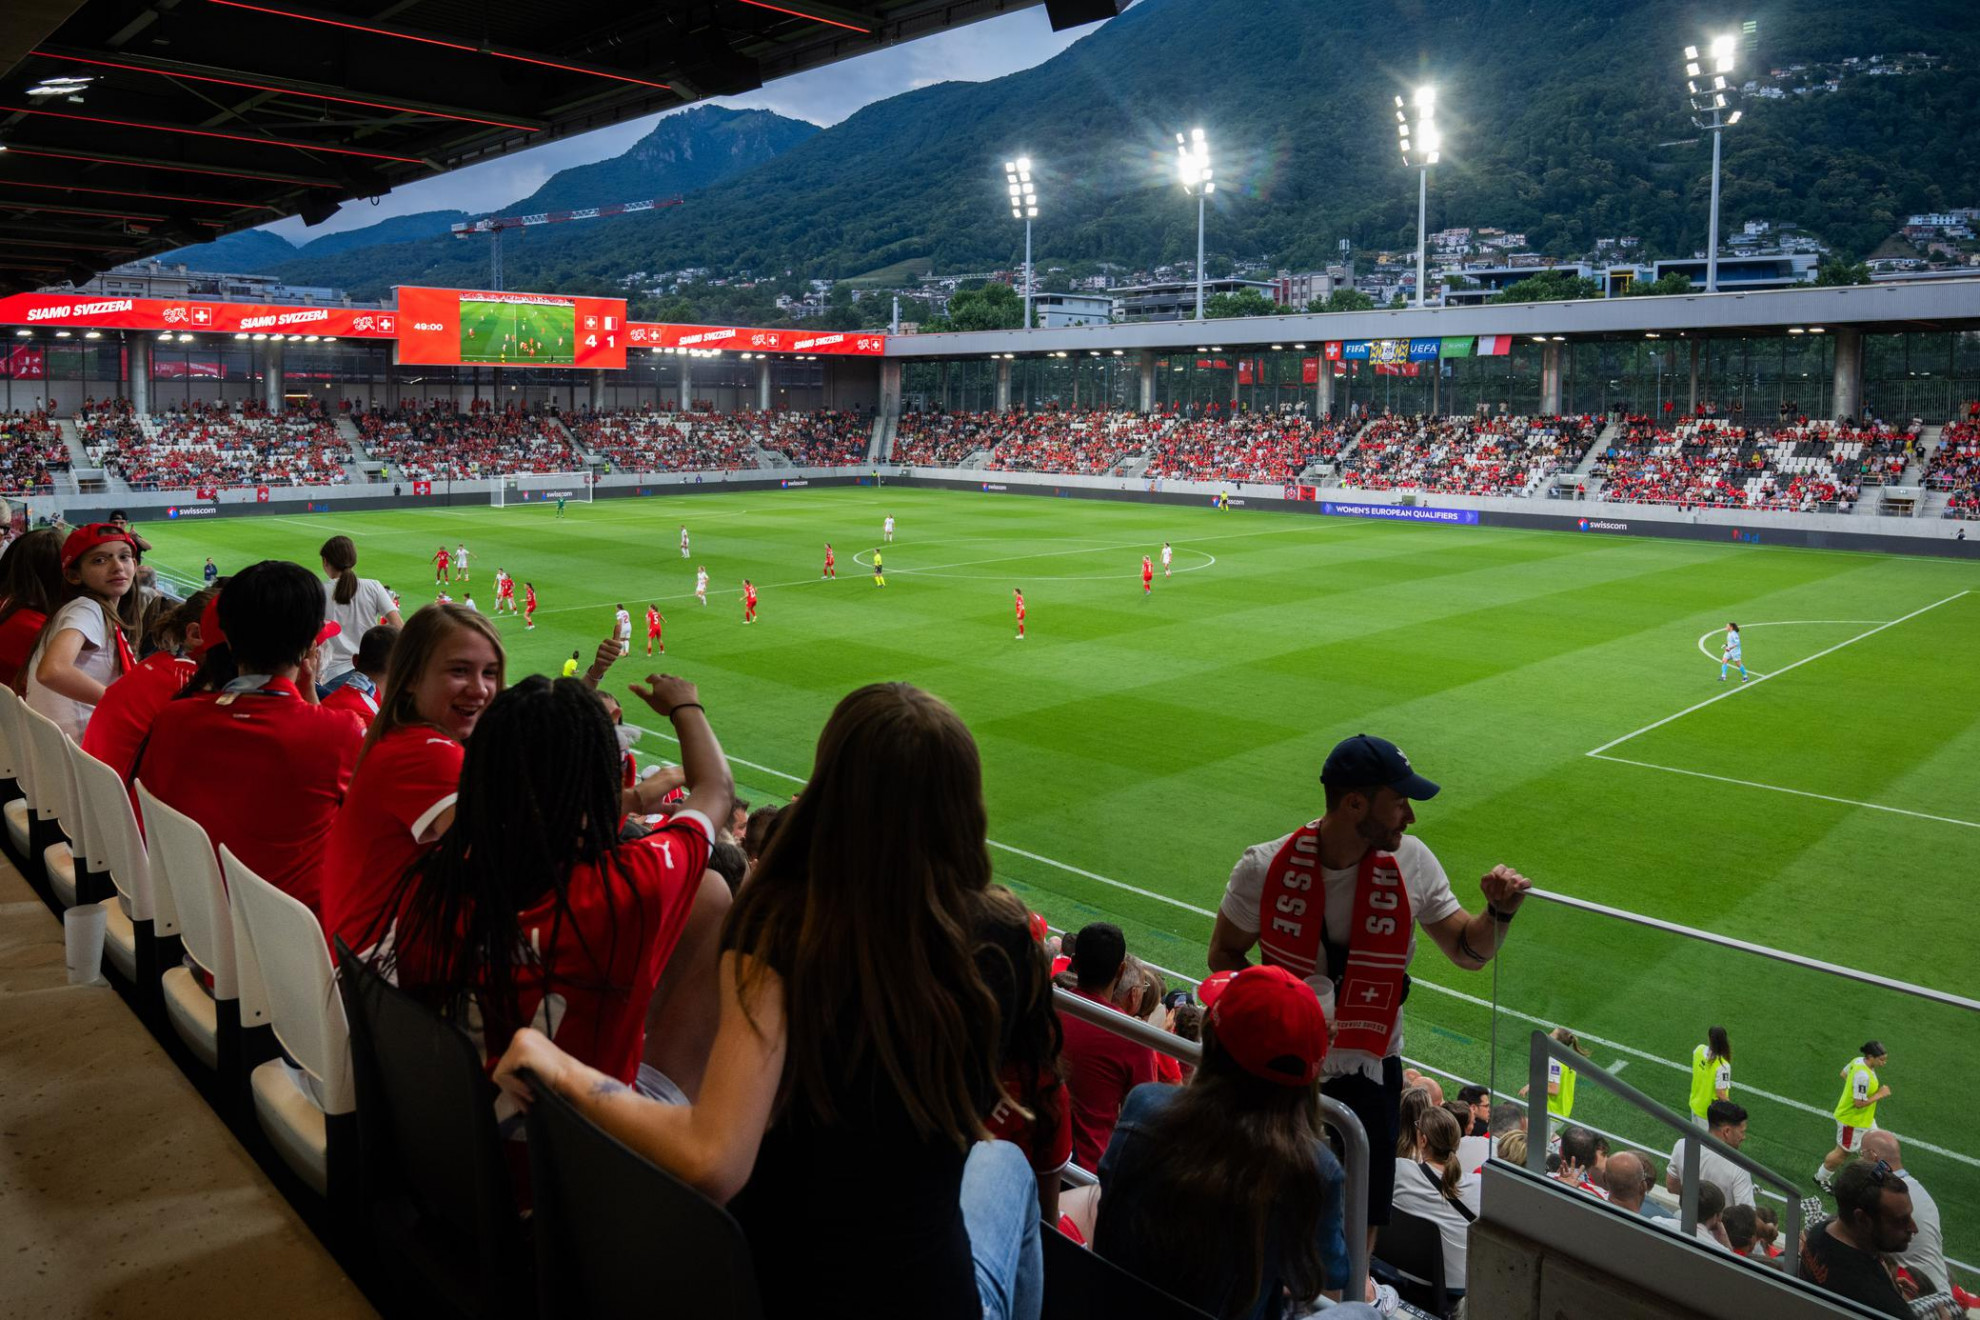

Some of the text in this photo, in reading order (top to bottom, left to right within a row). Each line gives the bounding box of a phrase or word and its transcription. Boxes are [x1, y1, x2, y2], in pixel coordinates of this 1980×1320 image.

[27, 300, 133, 321] SIAMO SVIZZERA
[240, 310, 328, 329] SIAMO SVIZZERA
[413, 323, 443, 331] 49:00
[585, 334, 615, 348] 4 1
[678, 329, 736, 345] SIAMO SVIZZERA
[1345, 345, 1366, 353] FIFA
[1410, 343, 1438, 353] UEFA
[547, 490, 573, 498] swisscom
[179, 507, 217, 516] swisscom
[1336, 505, 1459, 520] WOMEN'S EUROPEAN QUALIFIERS
[1589, 520, 1627, 530] swisscom
